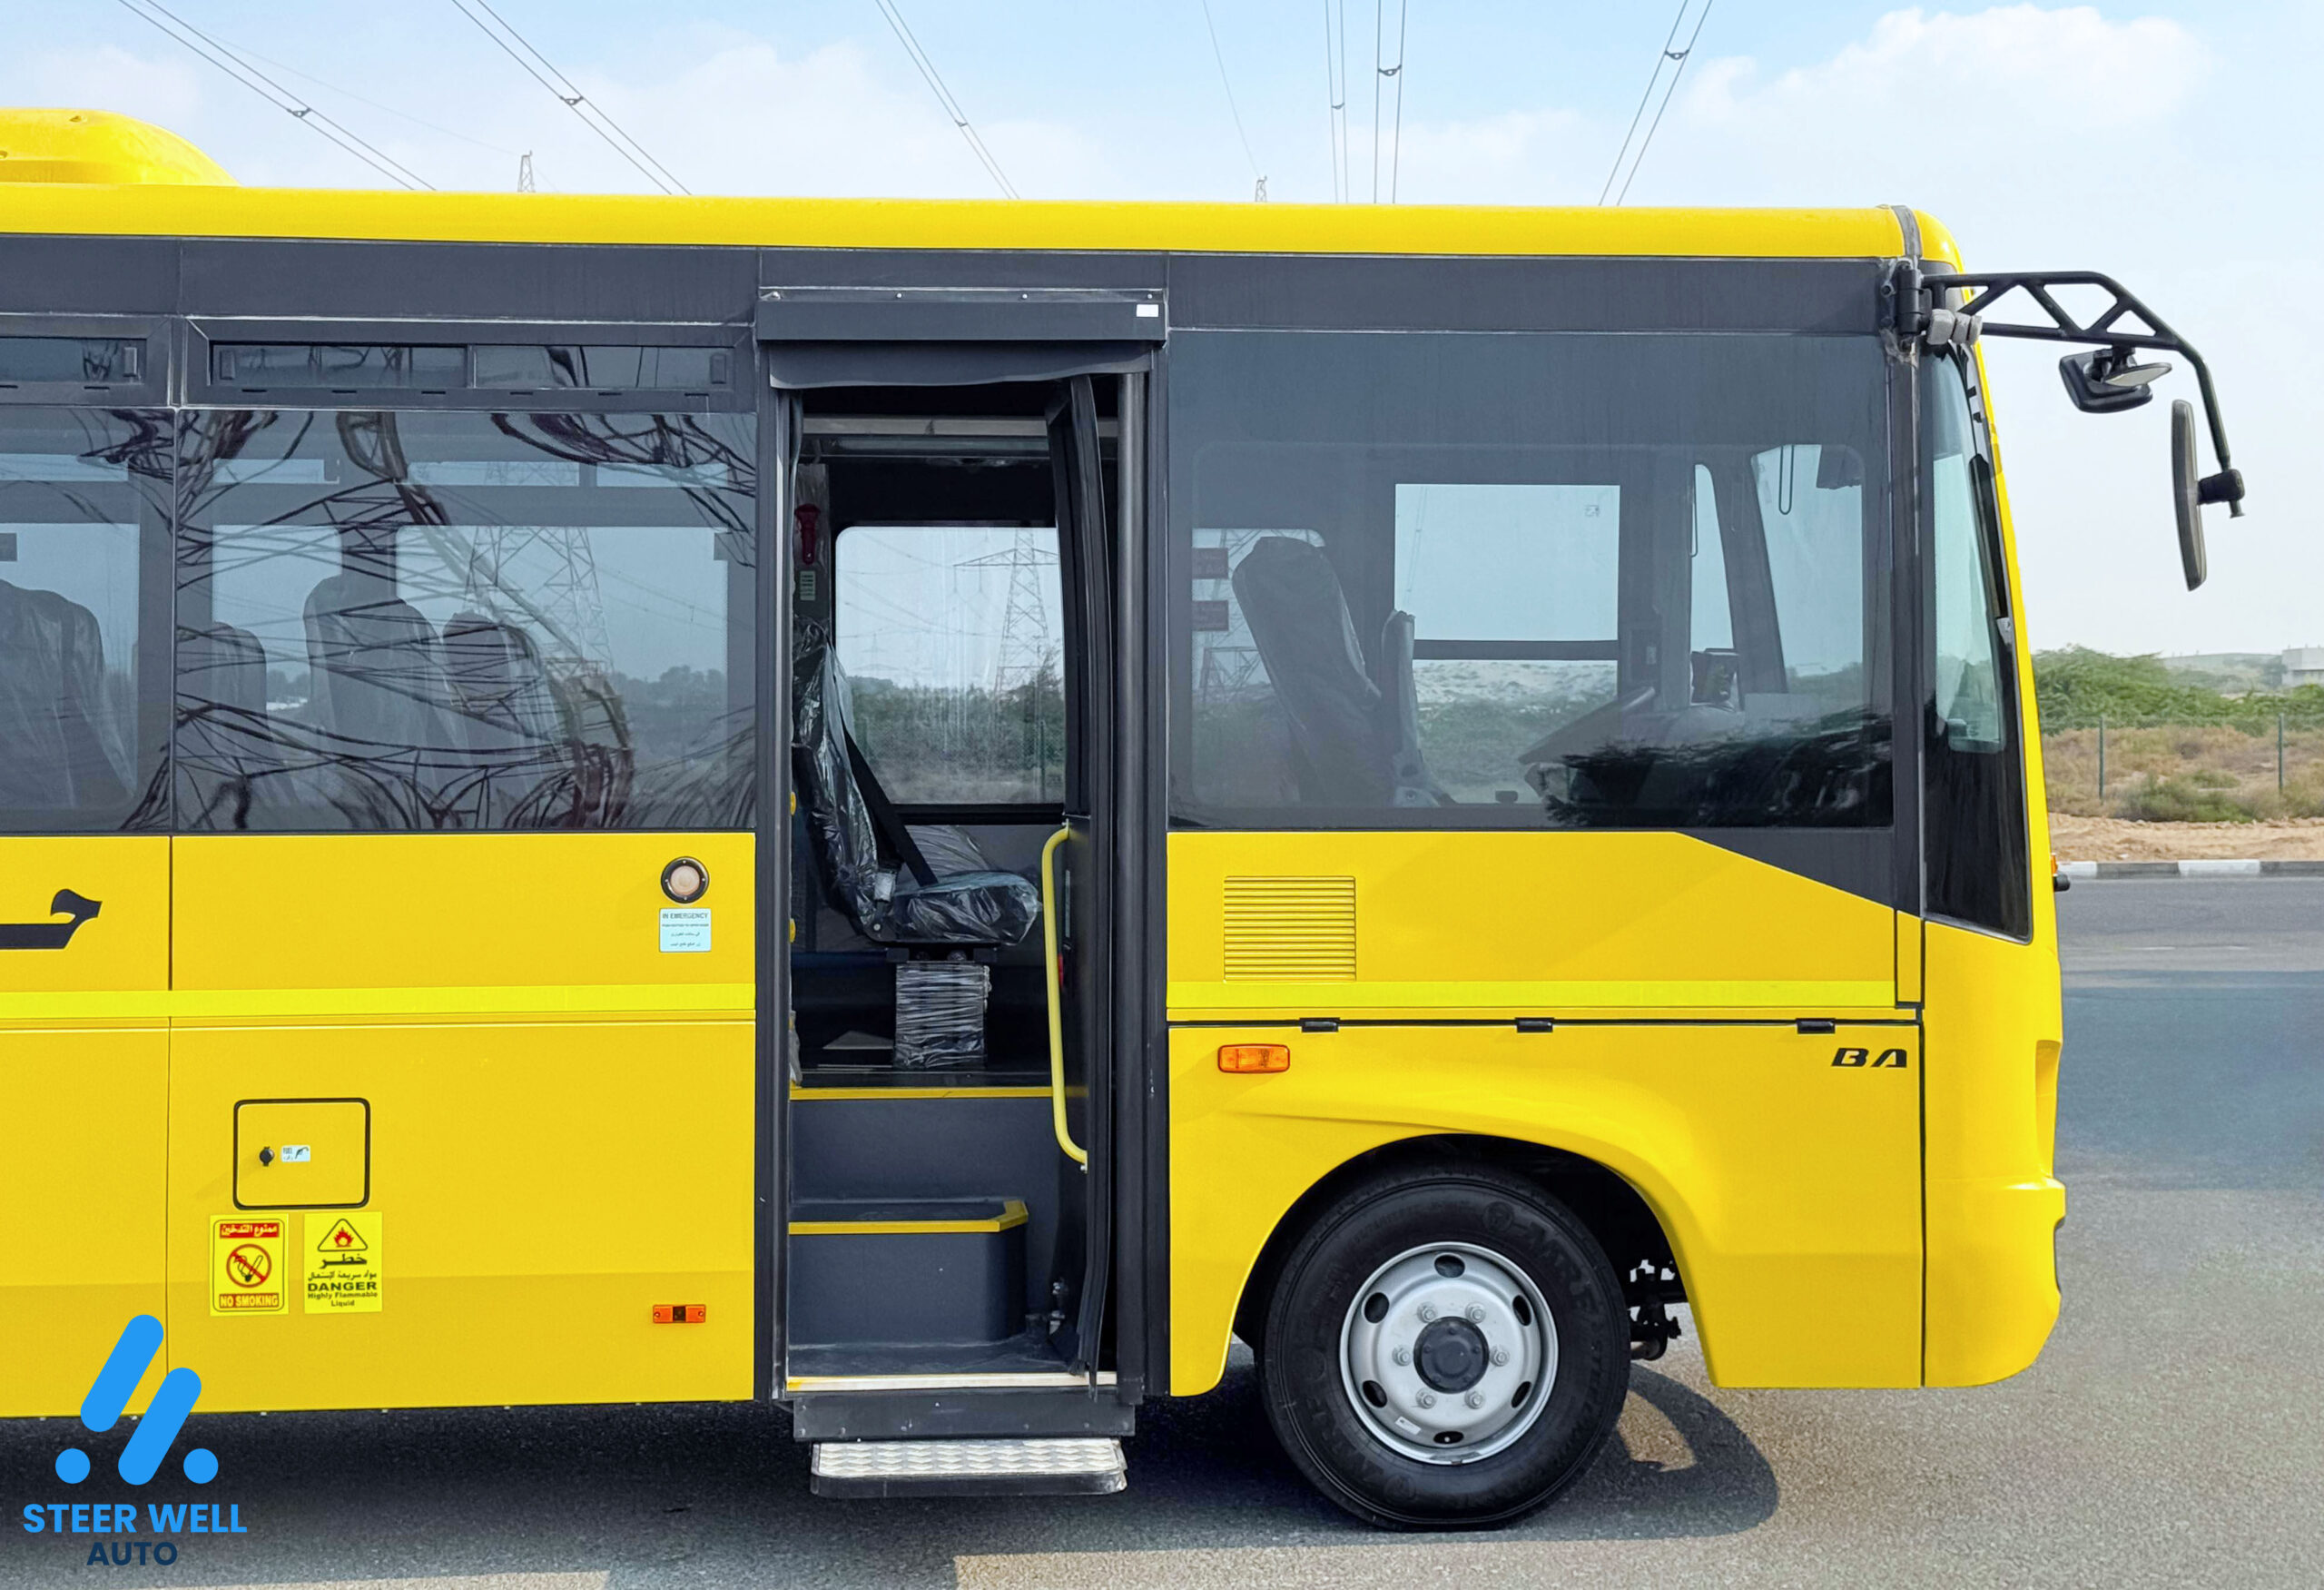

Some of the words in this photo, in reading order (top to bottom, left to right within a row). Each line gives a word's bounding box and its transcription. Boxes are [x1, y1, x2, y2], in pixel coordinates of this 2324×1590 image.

[1831, 1047, 1907, 1068] BA
[221, 1224, 253, 1236] التدخين
[253, 1224, 278, 1237] ممنوع
[308, 1281, 378, 1291] DANGER
[220, 1295, 234, 1308] NO
[235, 1293, 279, 1307] SMOKING
[308, 1292, 333, 1300] Highly
[330, 1299, 355, 1308] Liquid
